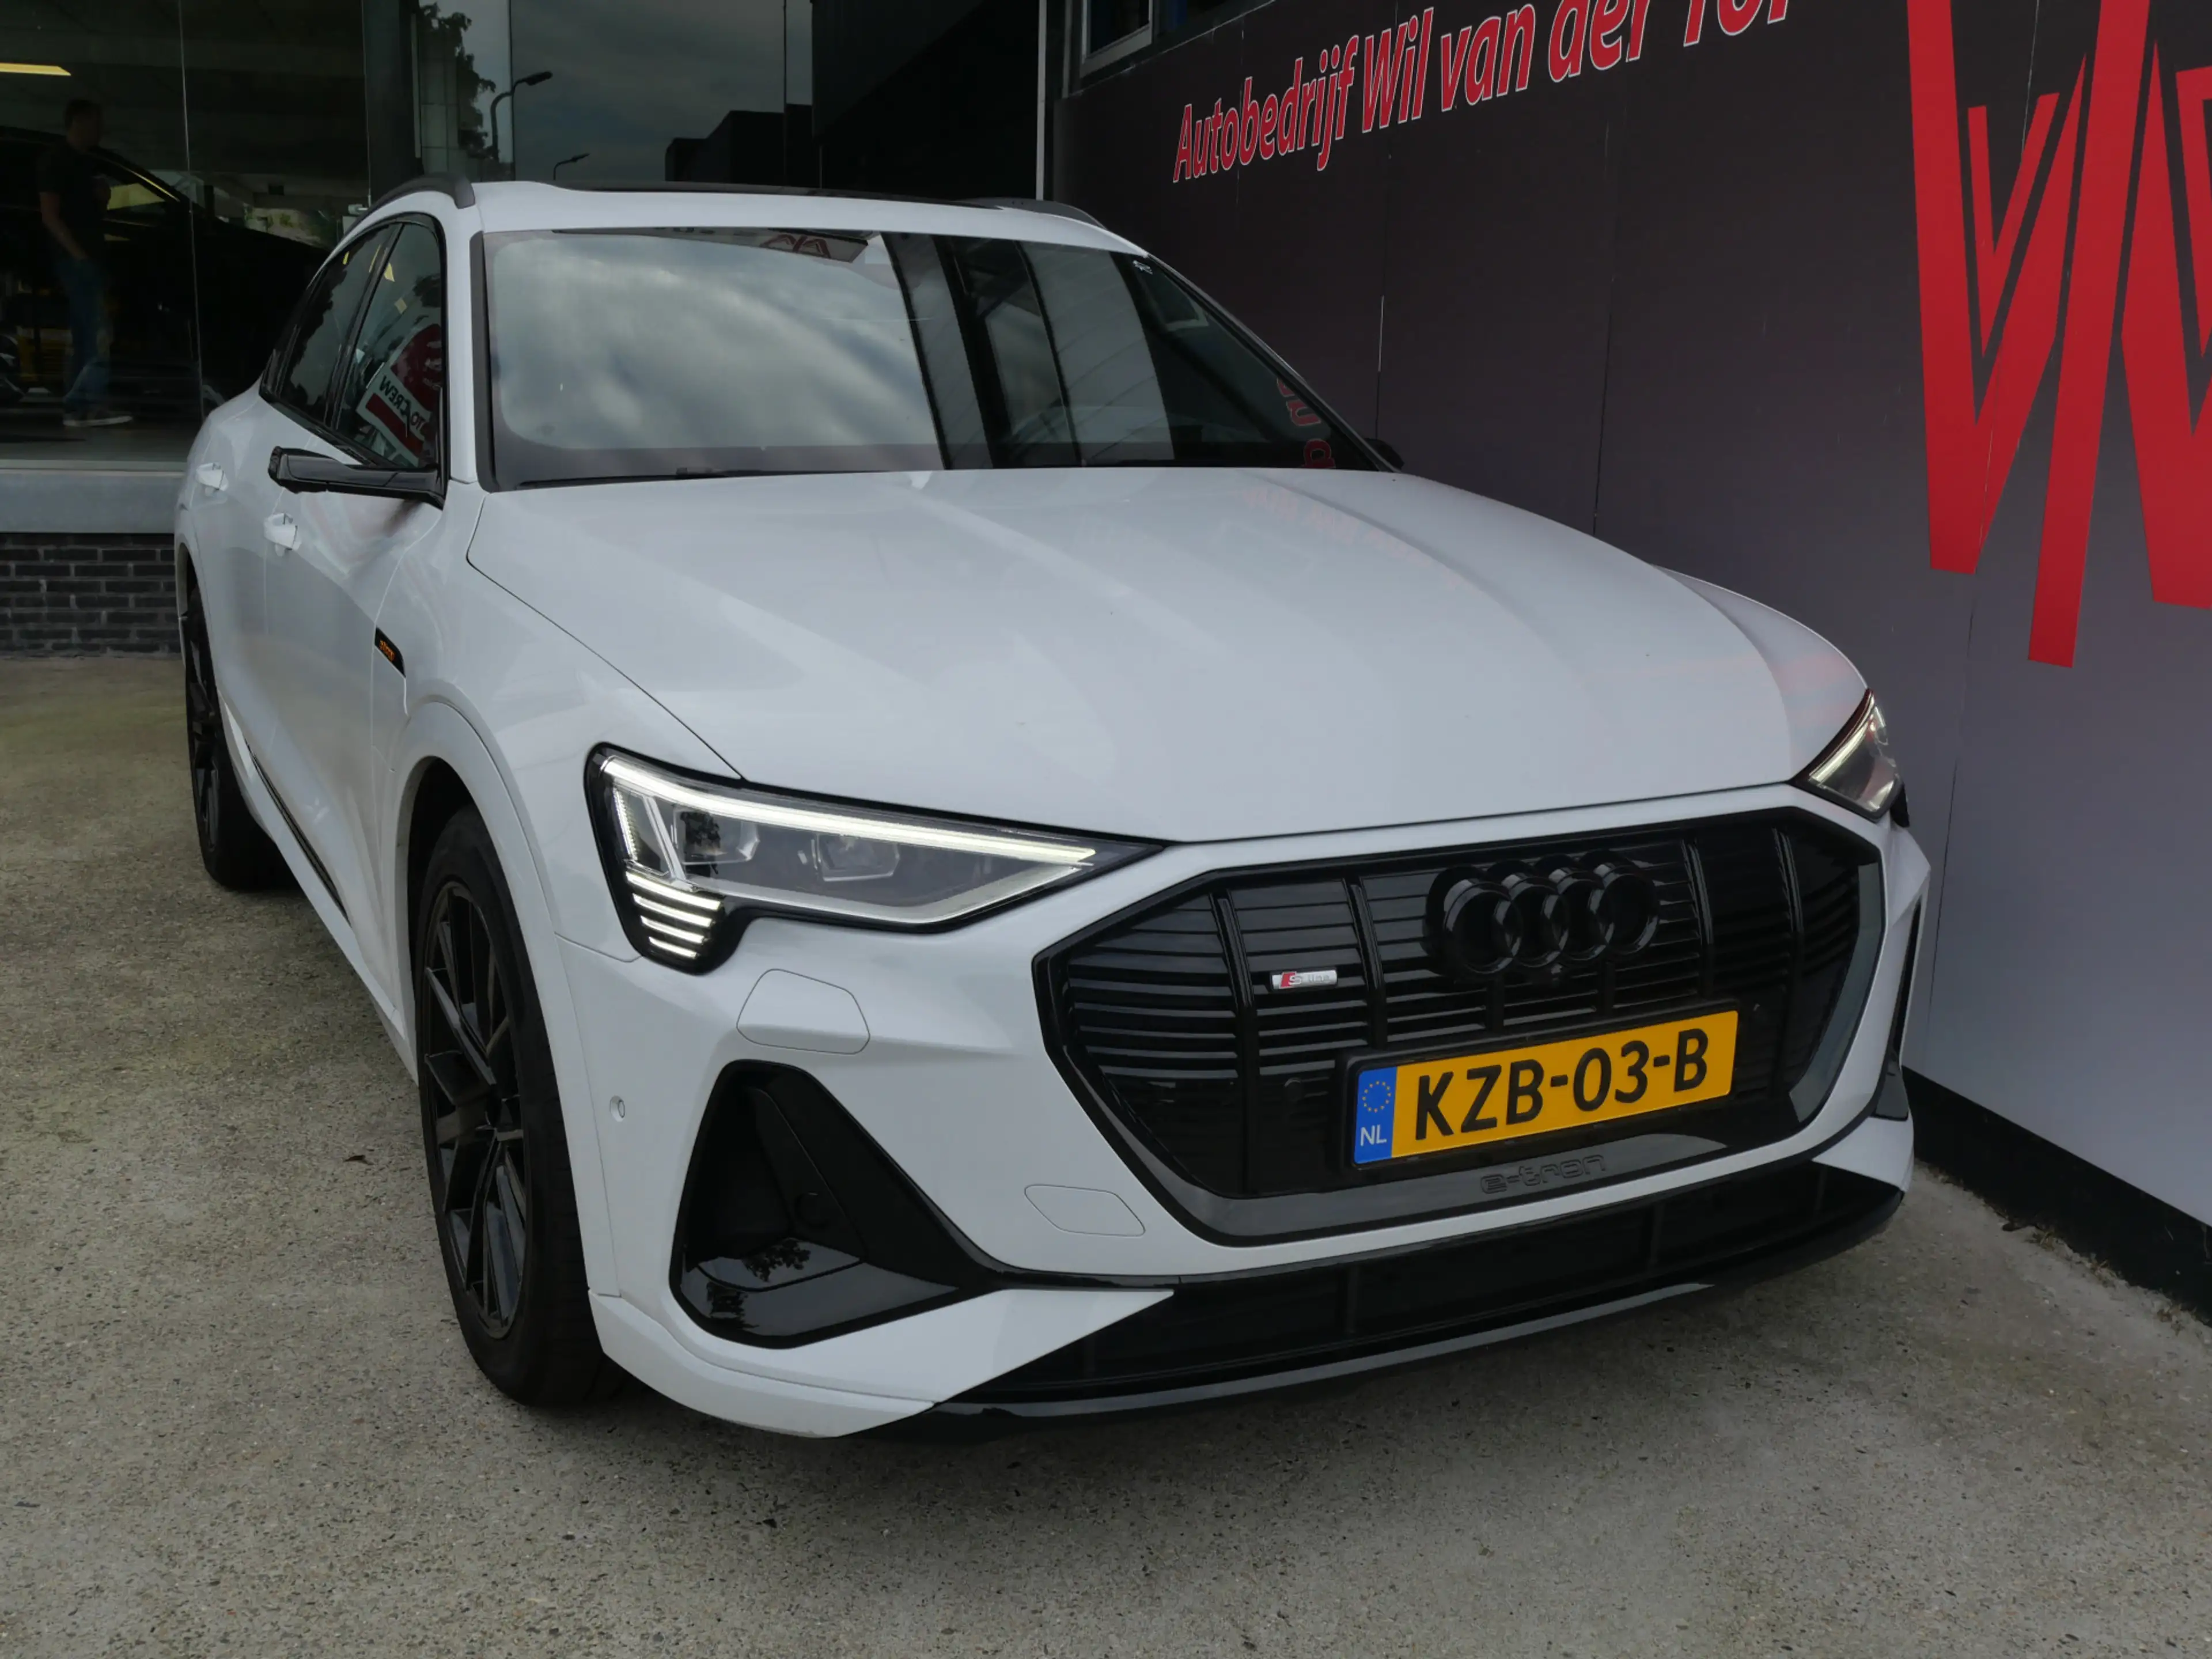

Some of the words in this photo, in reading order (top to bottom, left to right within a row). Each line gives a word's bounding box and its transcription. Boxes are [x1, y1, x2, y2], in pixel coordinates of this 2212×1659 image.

[1172, 35, 1359, 184] Autobedrijf
[1362, 6, 1434, 134] Wil
[1440, 3, 1536, 112] van
[1548, 0, 1651, 82] der
[1414, 1028, 1709, 1141] KZB-03-B
[1359, 1124, 1387, 1146] NL
[1480, 1154, 1606, 1194] e-tron
